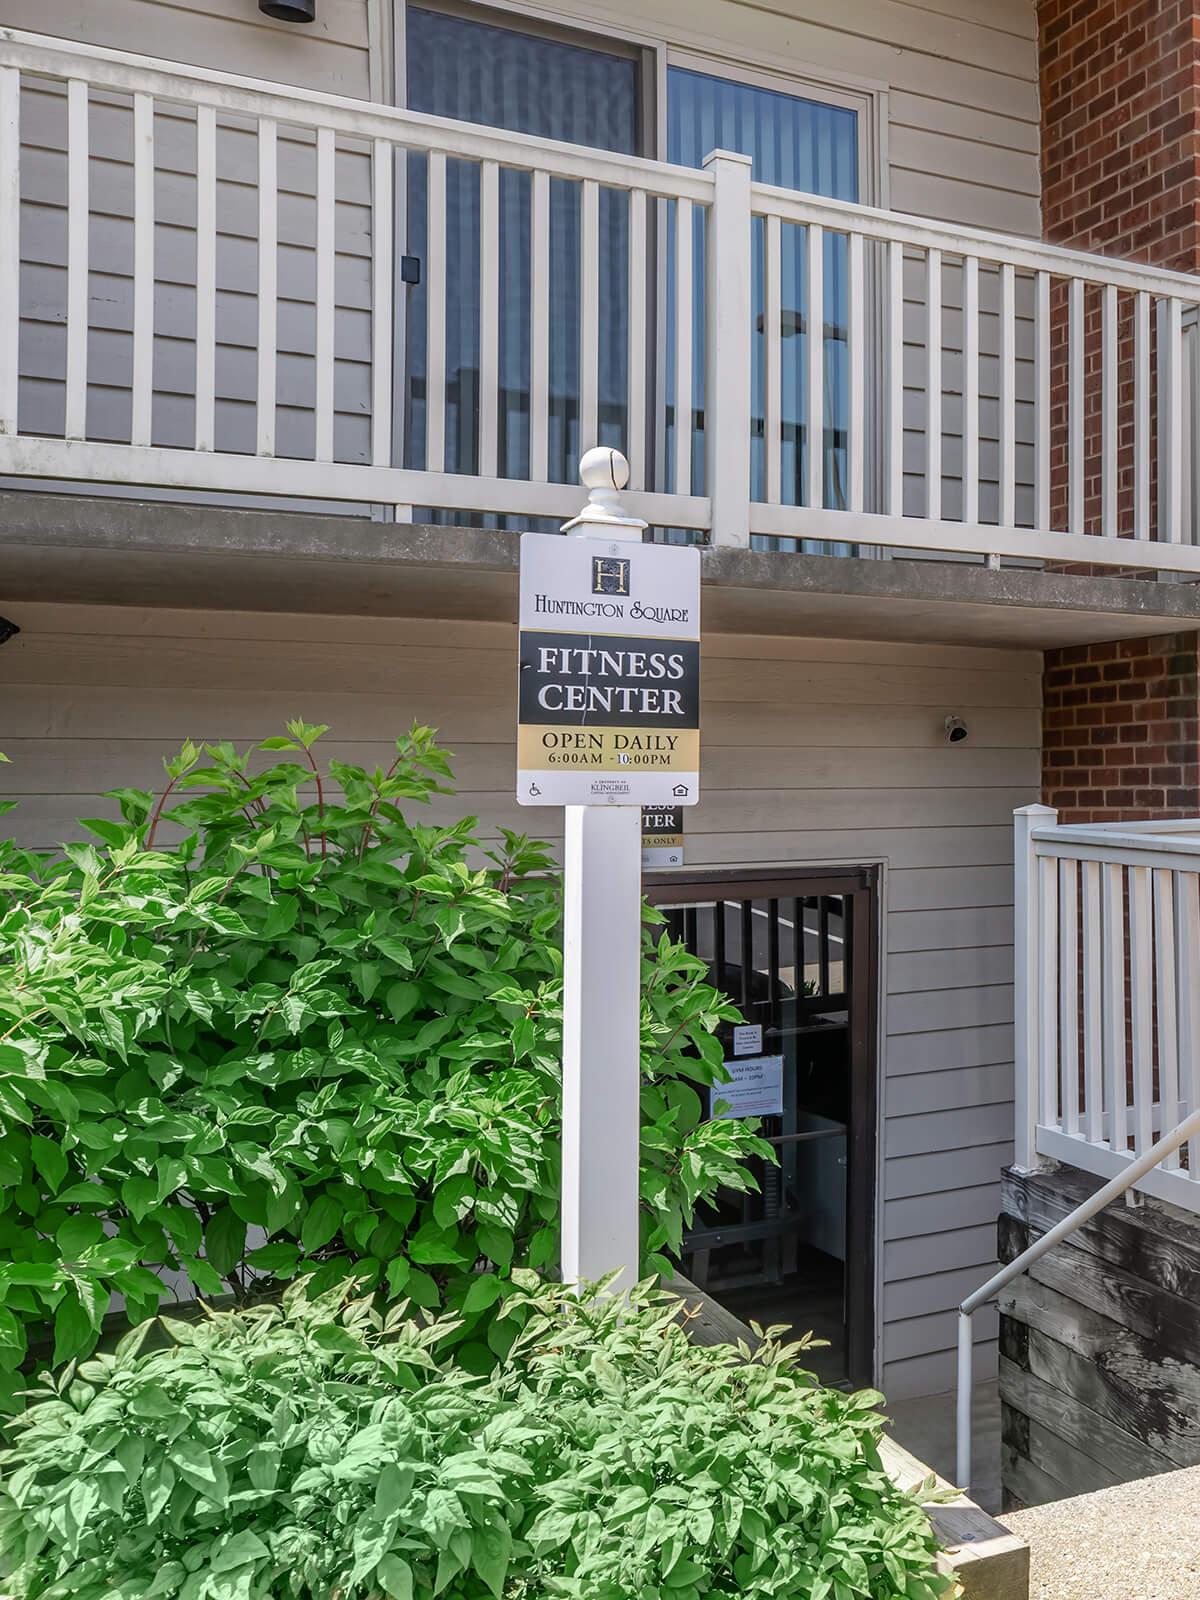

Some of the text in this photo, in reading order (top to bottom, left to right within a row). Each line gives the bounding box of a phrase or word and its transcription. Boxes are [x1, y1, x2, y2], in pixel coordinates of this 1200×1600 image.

[594, 559, 627, 593] H
[535, 594, 689, 623] HUNTINGTON SQUARE
[537, 647, 684, 680] FITNESS
[537, 684, 685, 715] CENTER
[542, 732, 679, 750] OPEN DAILY
[548, 752, 602, 764] 6:00AM
[642, 814, 676, 827] TER
[654, 837, 676, 845] ONLY
